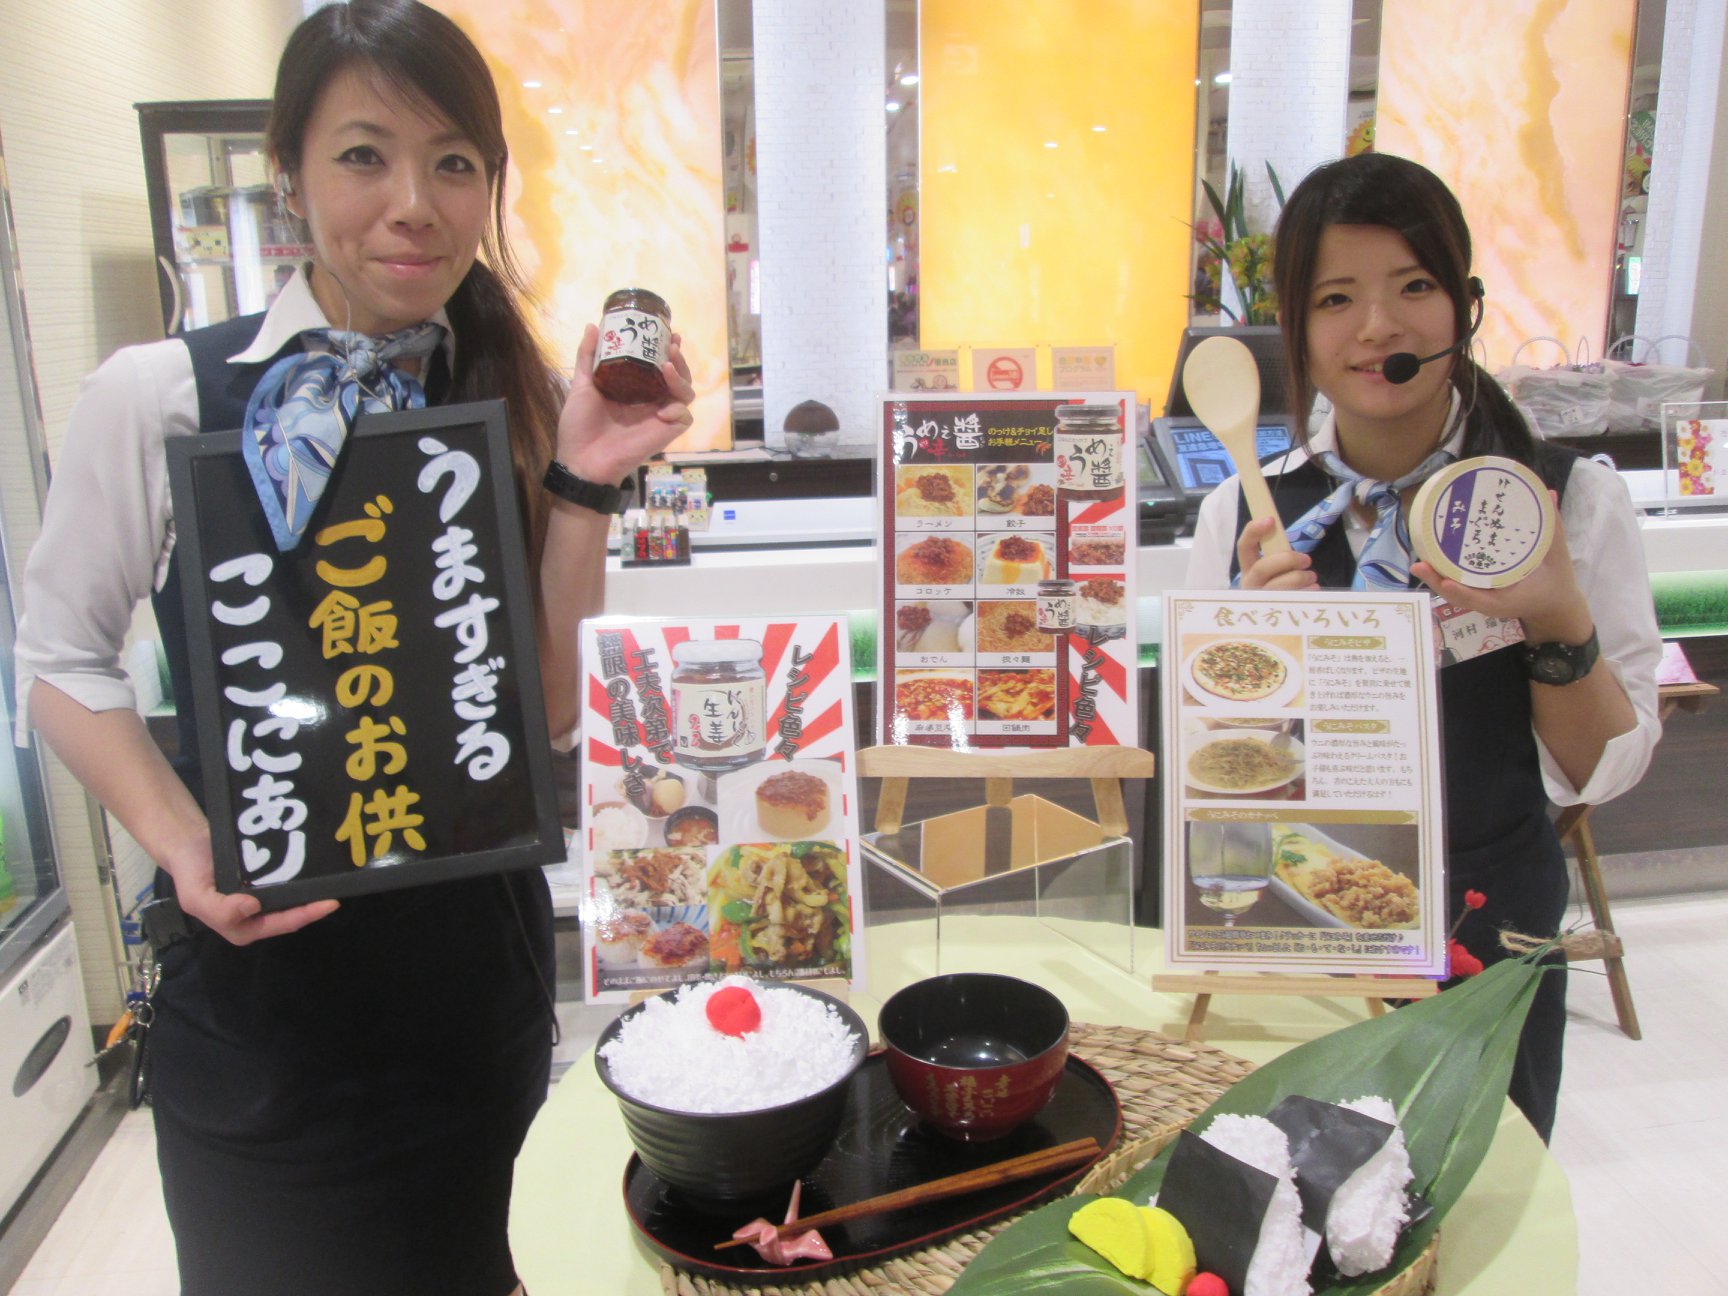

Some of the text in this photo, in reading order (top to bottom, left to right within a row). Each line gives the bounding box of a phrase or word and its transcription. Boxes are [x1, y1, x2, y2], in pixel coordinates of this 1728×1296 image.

[1174, 431, 1211, 443] LINE
[915, 519, 952, 528] ラーメン
[1006, 518, 1026, 528] 餃子
[1472, 499, 1488, 544] まぐろ
[417, 437, 511, 781] うますぎる
[915, 587, 952, 595] コロッケ
[1214, 606, 1381, 628] 食べ方いろいろ
[309, 495, 427, 867] ご飯のお供
[920, 655, 948, 664] おでん
[631, 648, 675, 764] 工夫次第で
[774, 645, 813, 762] レシピ色々
[1070, 625, 1108, 743] レシピ色々
[209, 553, 308, 885] ここにあり
[597, 632, 646, 796] 無限の美味しさ
[703, 697, 728, 743] 生姜
